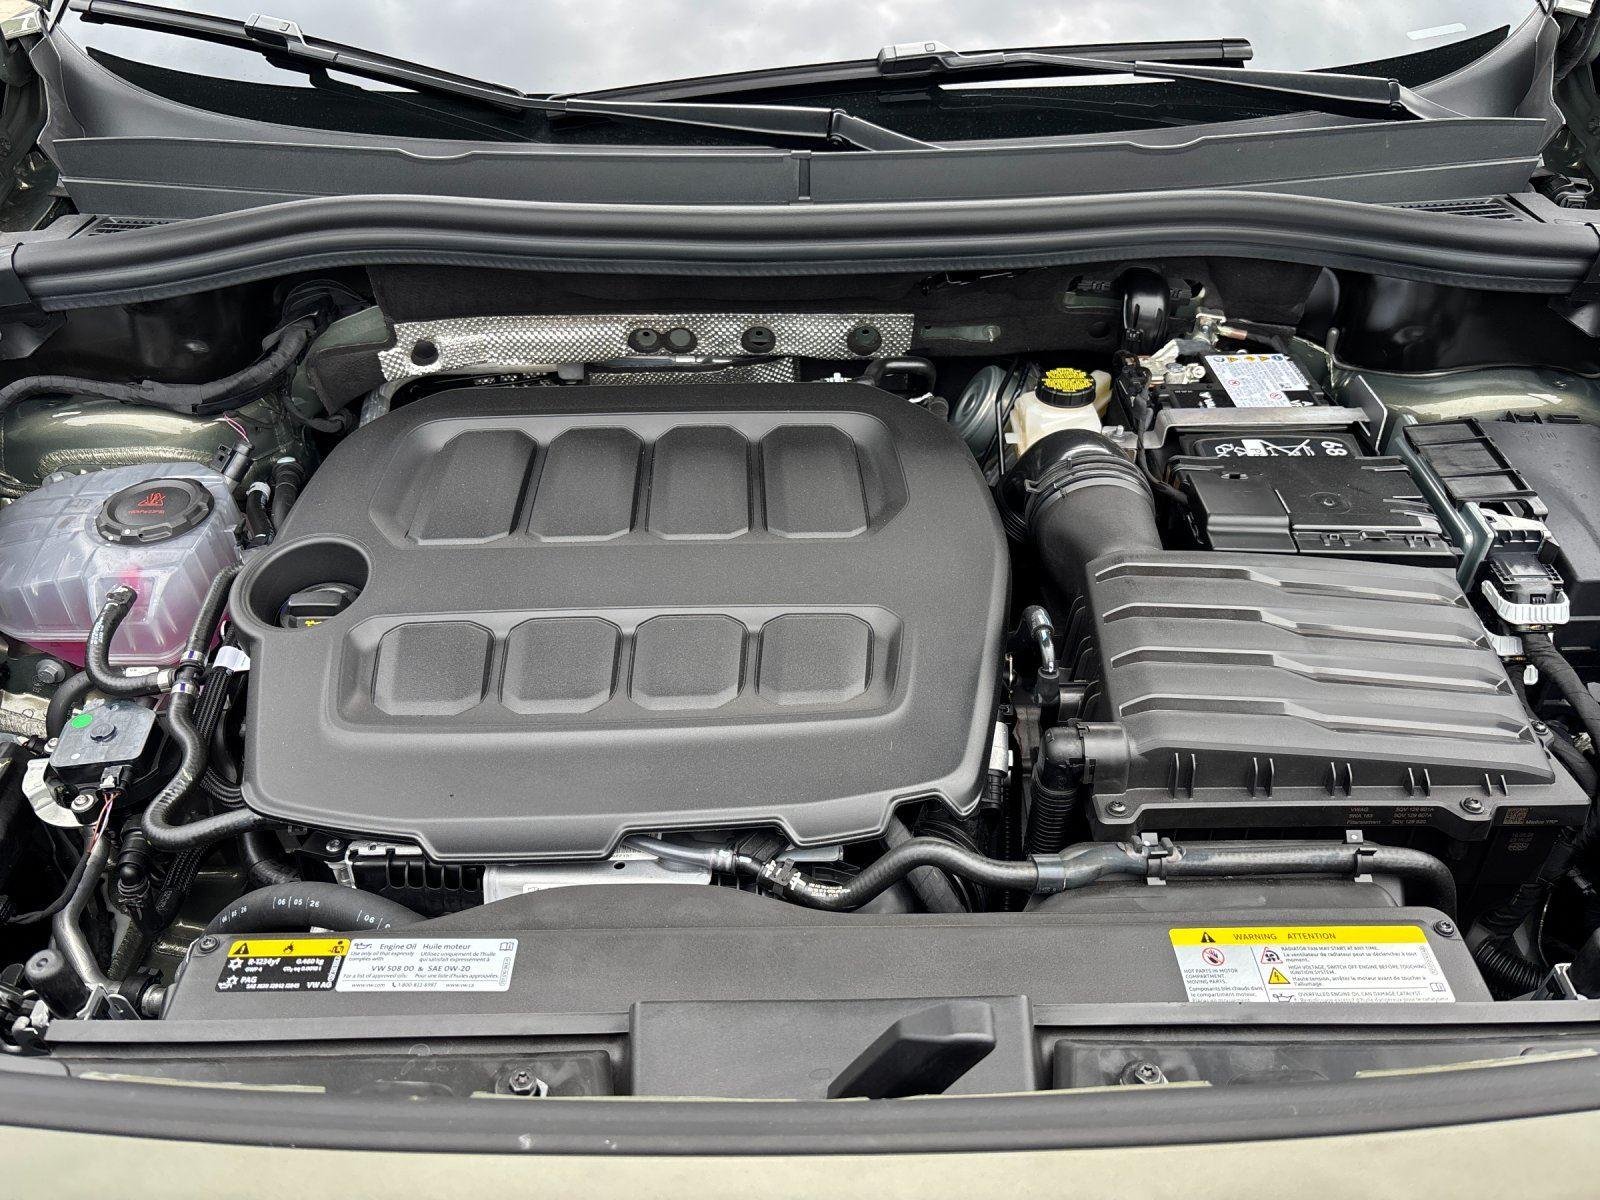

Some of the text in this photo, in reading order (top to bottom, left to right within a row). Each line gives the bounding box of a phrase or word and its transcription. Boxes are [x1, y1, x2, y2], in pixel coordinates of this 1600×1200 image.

[277, 898, 320, 908] 06 05 26
[364, 914, 375, 924] 06
[379, 943, 404, 951] Engine
[307, 981, 332, 989] VW AG
